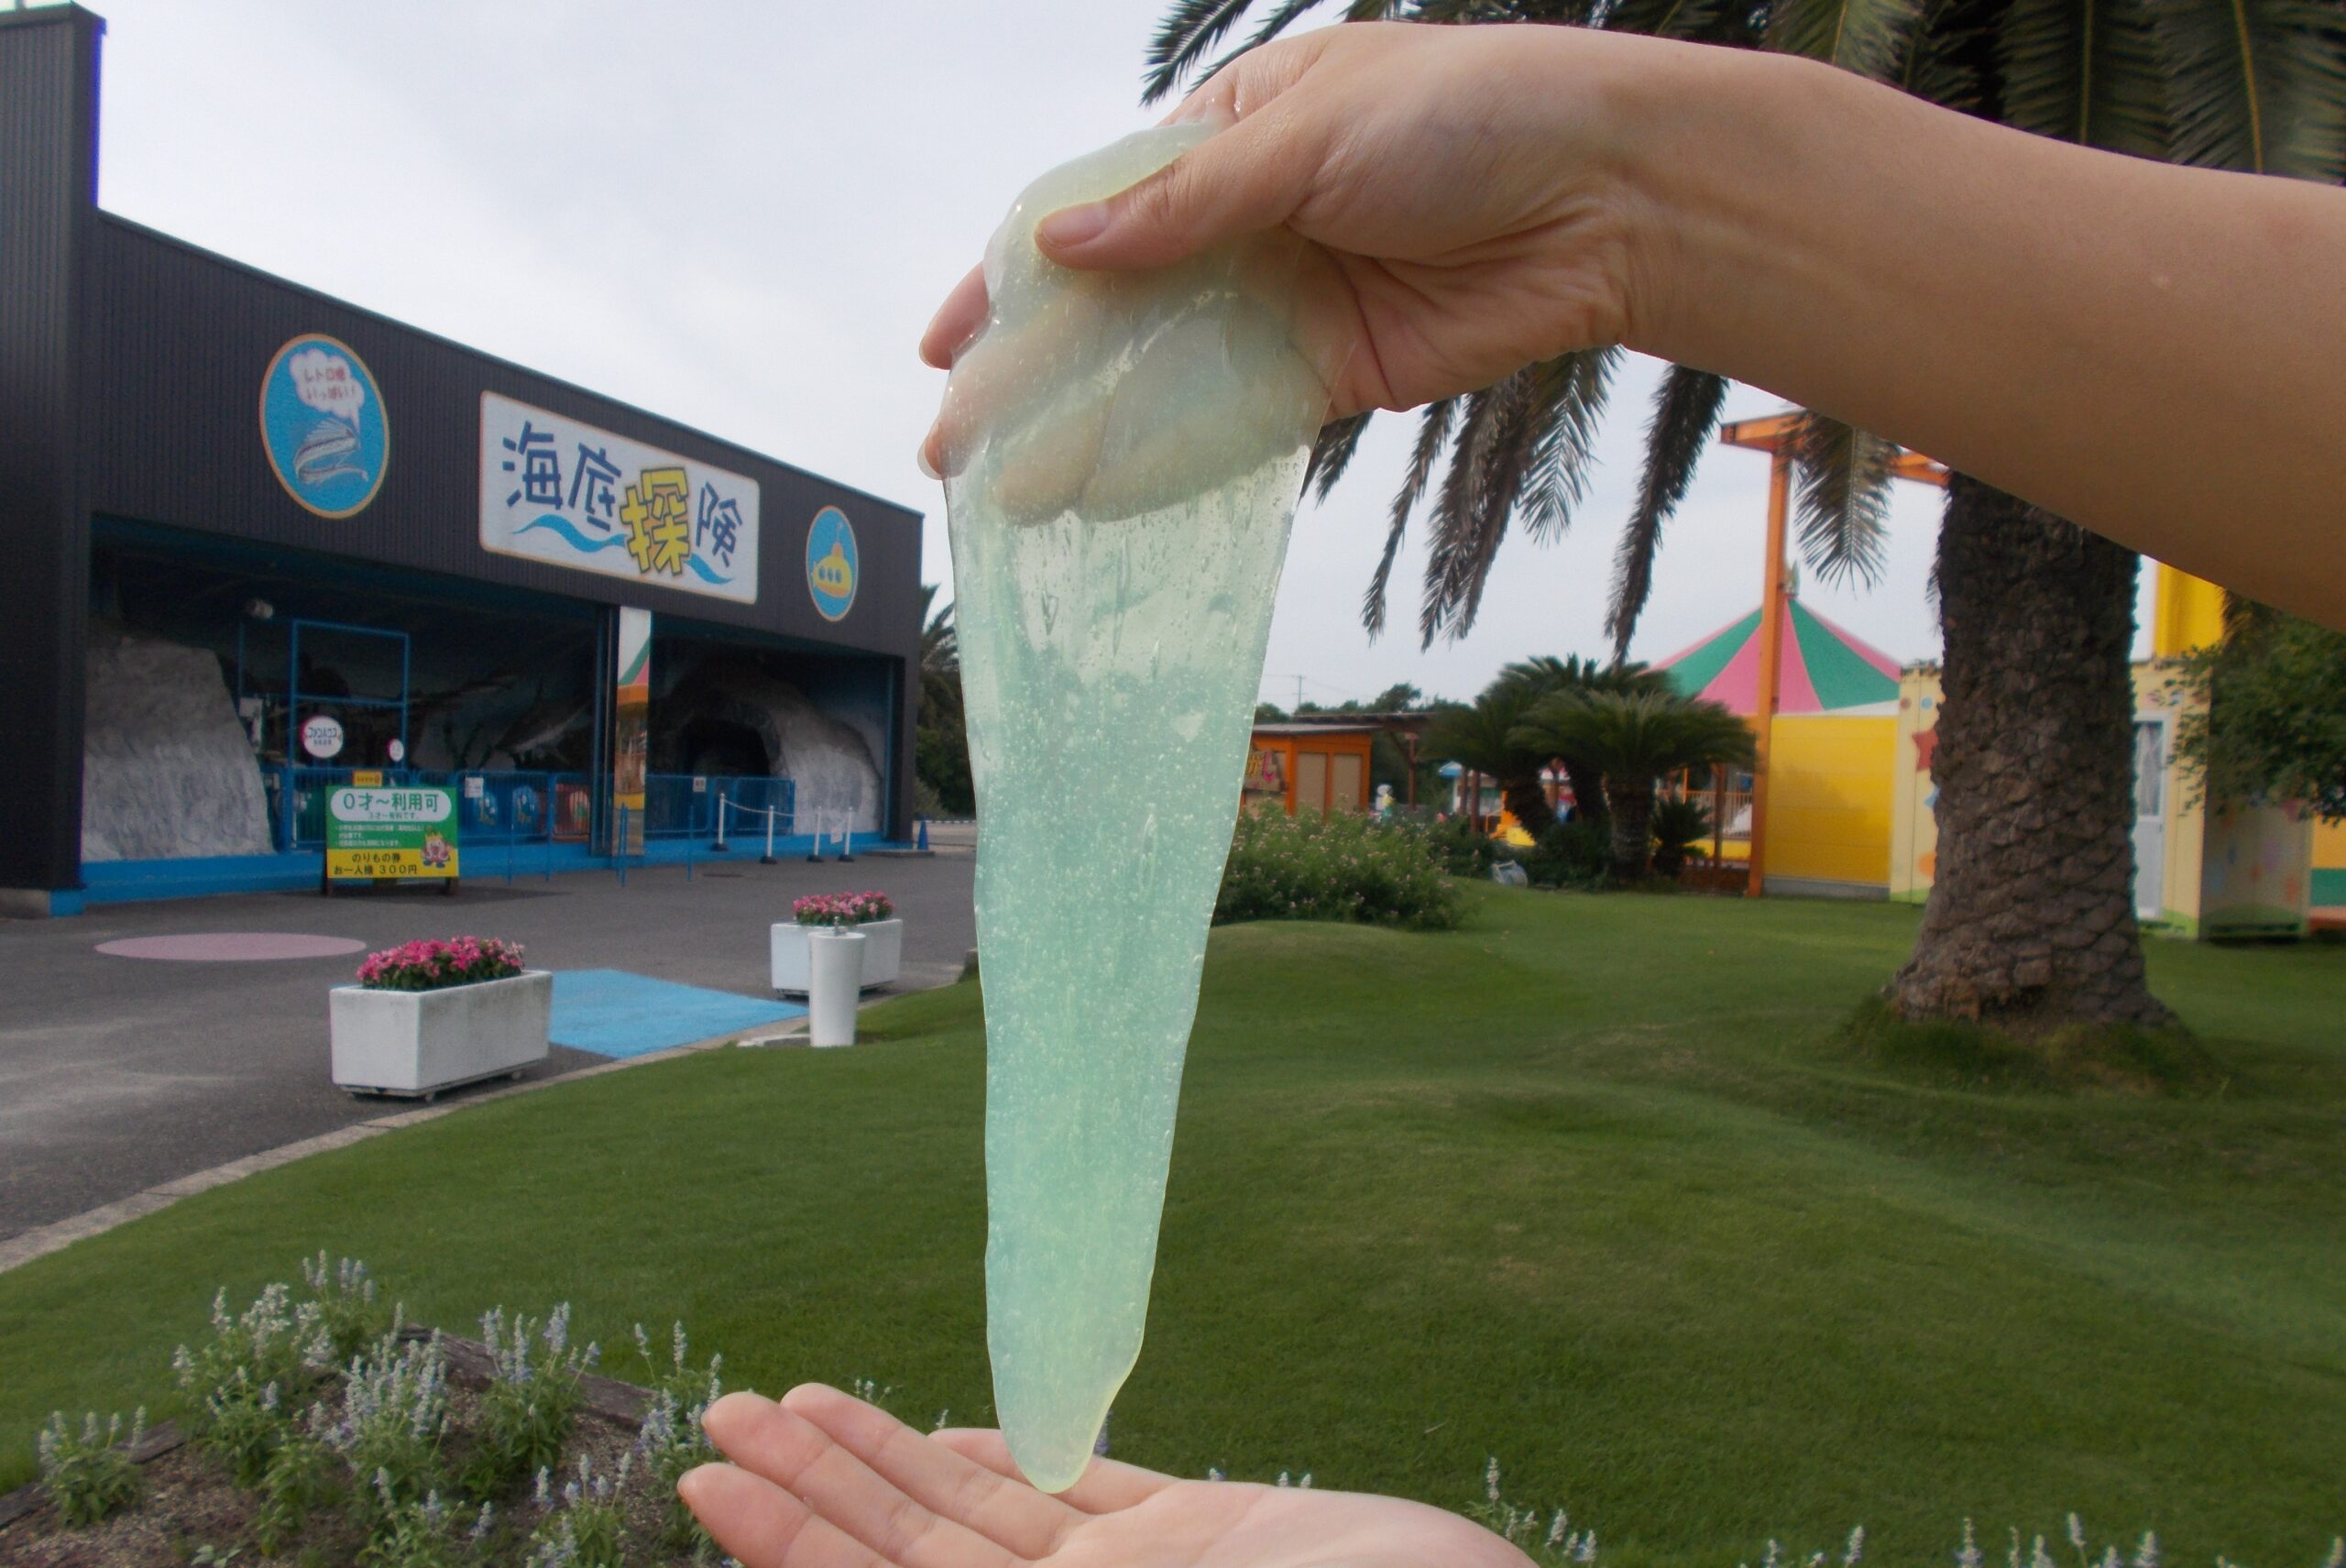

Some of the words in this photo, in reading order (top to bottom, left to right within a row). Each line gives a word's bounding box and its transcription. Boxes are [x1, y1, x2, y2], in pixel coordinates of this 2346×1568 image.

[502, 421, 743, 576] 海底探険
[352, 852, 400, 863] のりもの券
[378, 864, 417, 874] 300円
